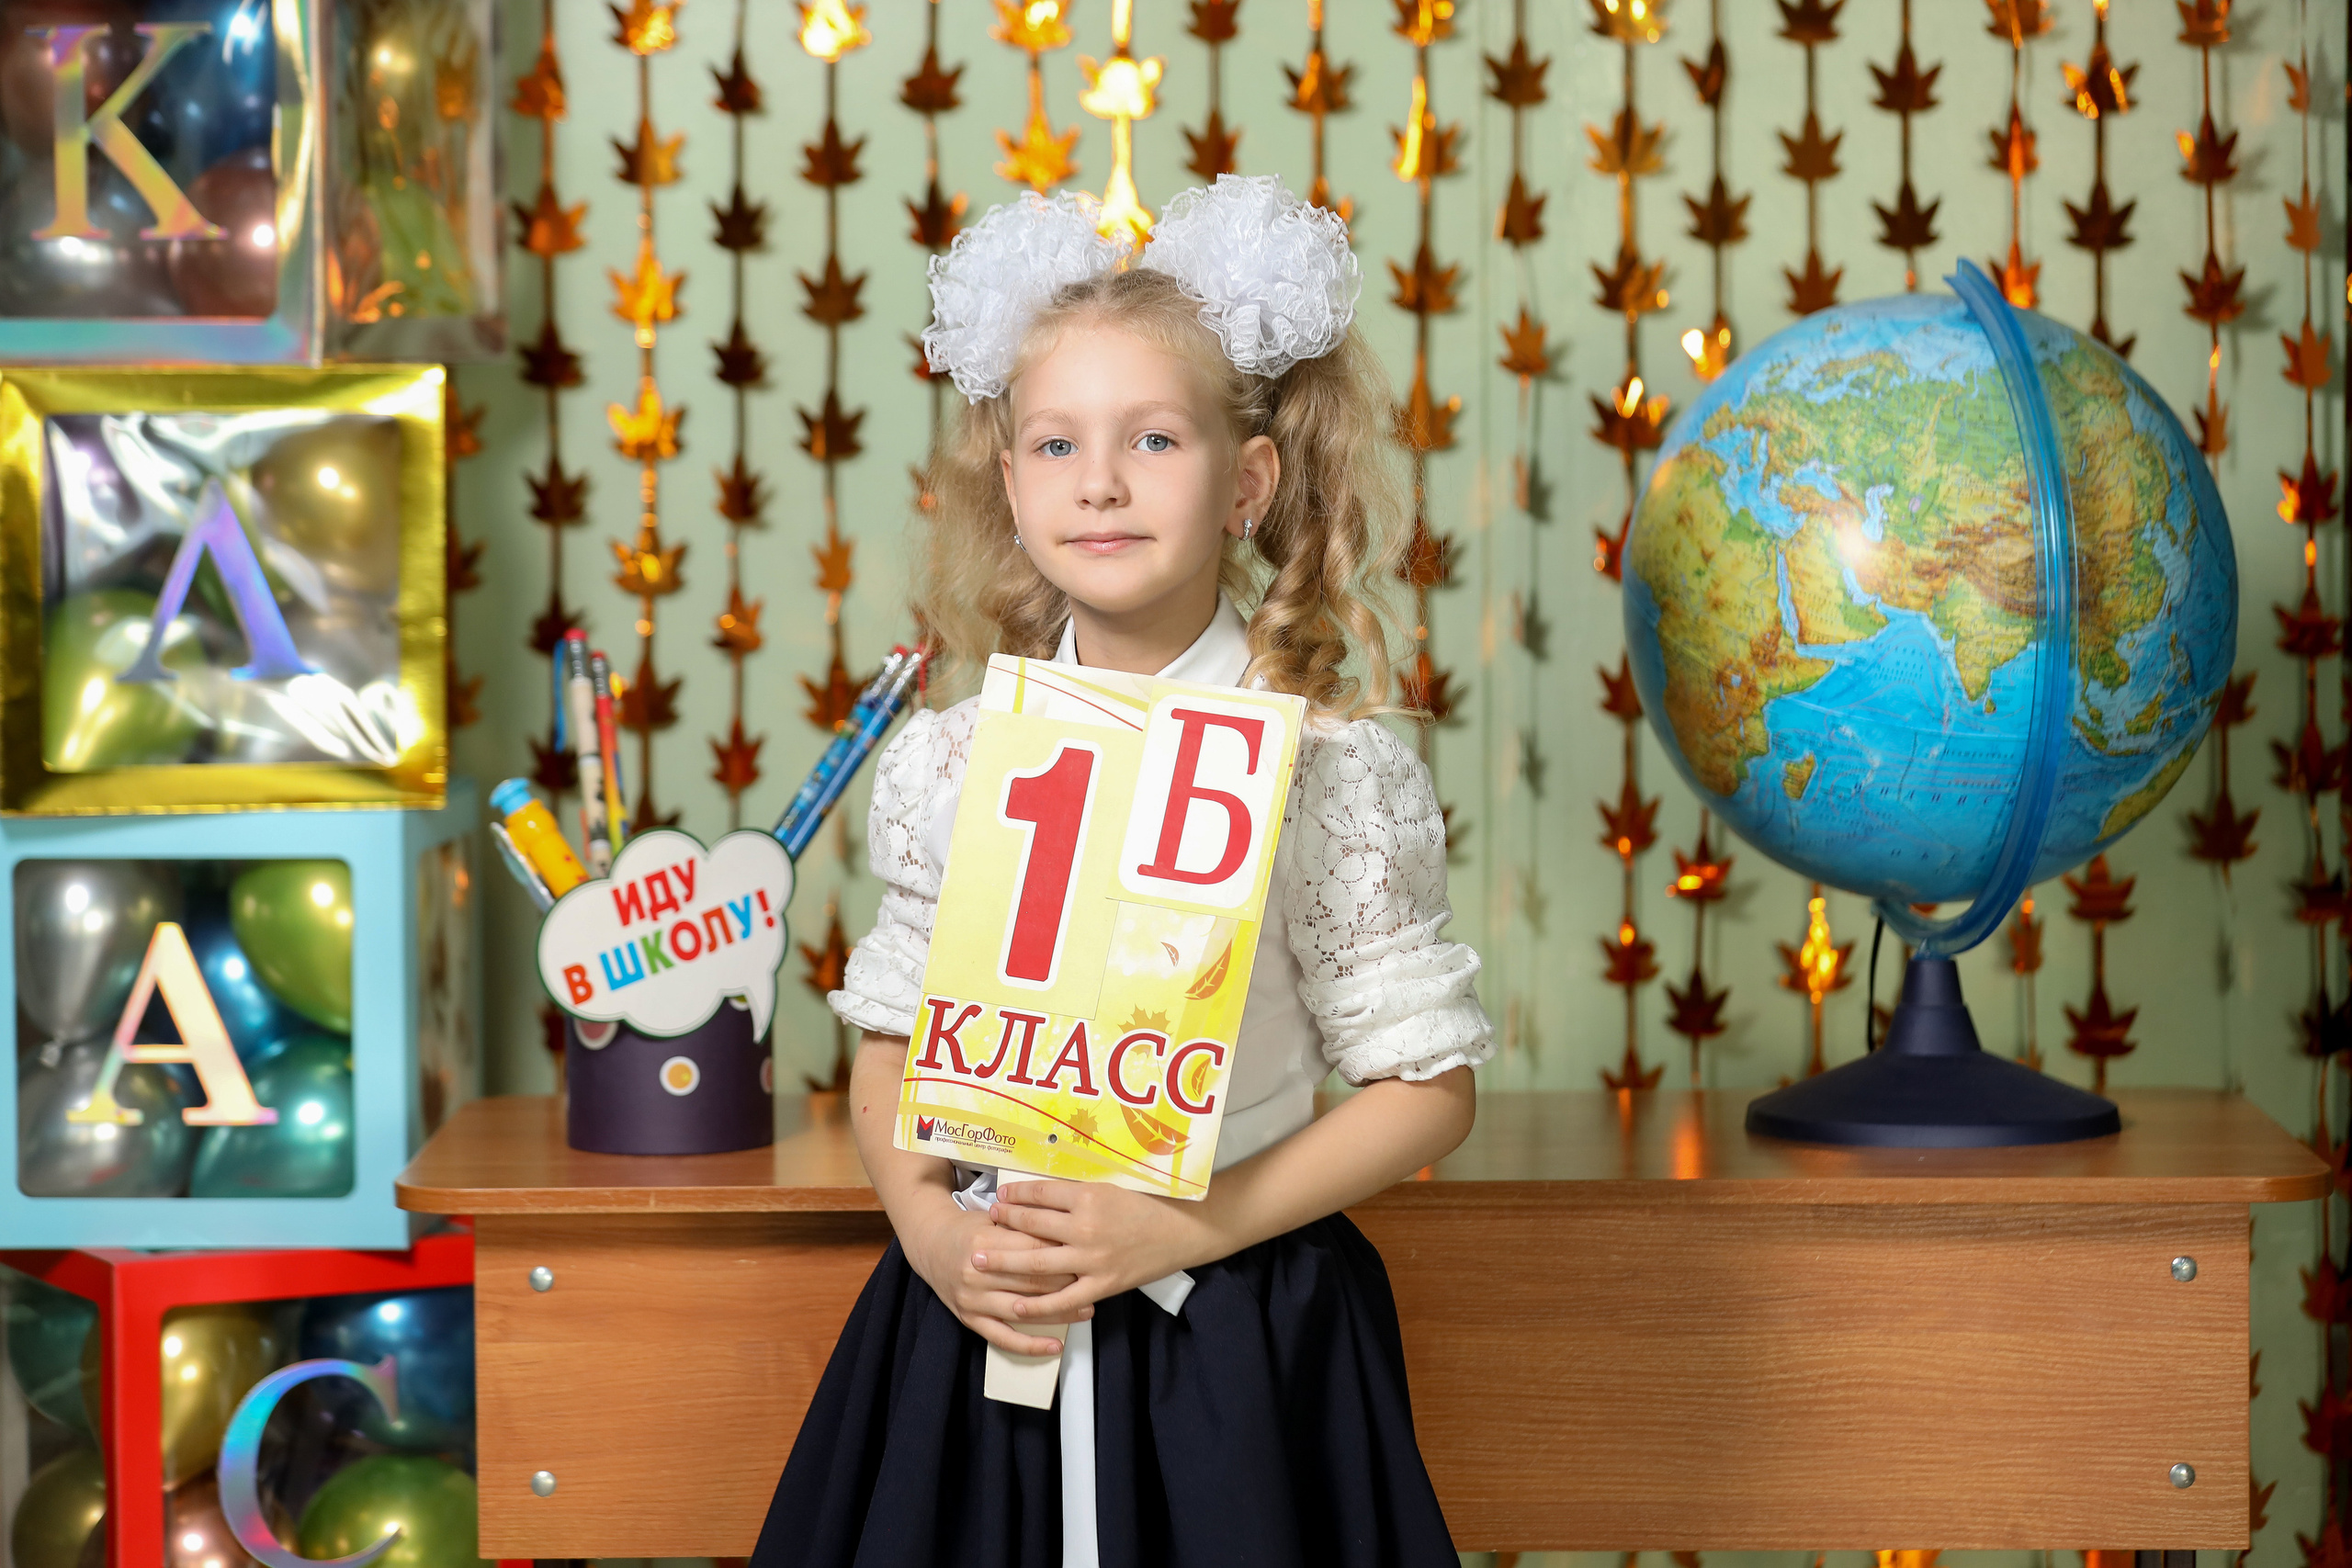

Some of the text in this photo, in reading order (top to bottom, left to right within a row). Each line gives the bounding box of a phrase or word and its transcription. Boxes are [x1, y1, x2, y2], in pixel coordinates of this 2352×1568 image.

[25, 23, 227, 241] К
[611, 857, 695, 928] ИДУ
[1005, 707, 1264, 982] 1 Б
[563, 888, 775, 1006] В ШКОЛУ!
[65, 921, 279, 1126] А
[914, 998, 1225, 1115] КЛАСС
[934, 1119, 1016, 1146] МосГорФото
